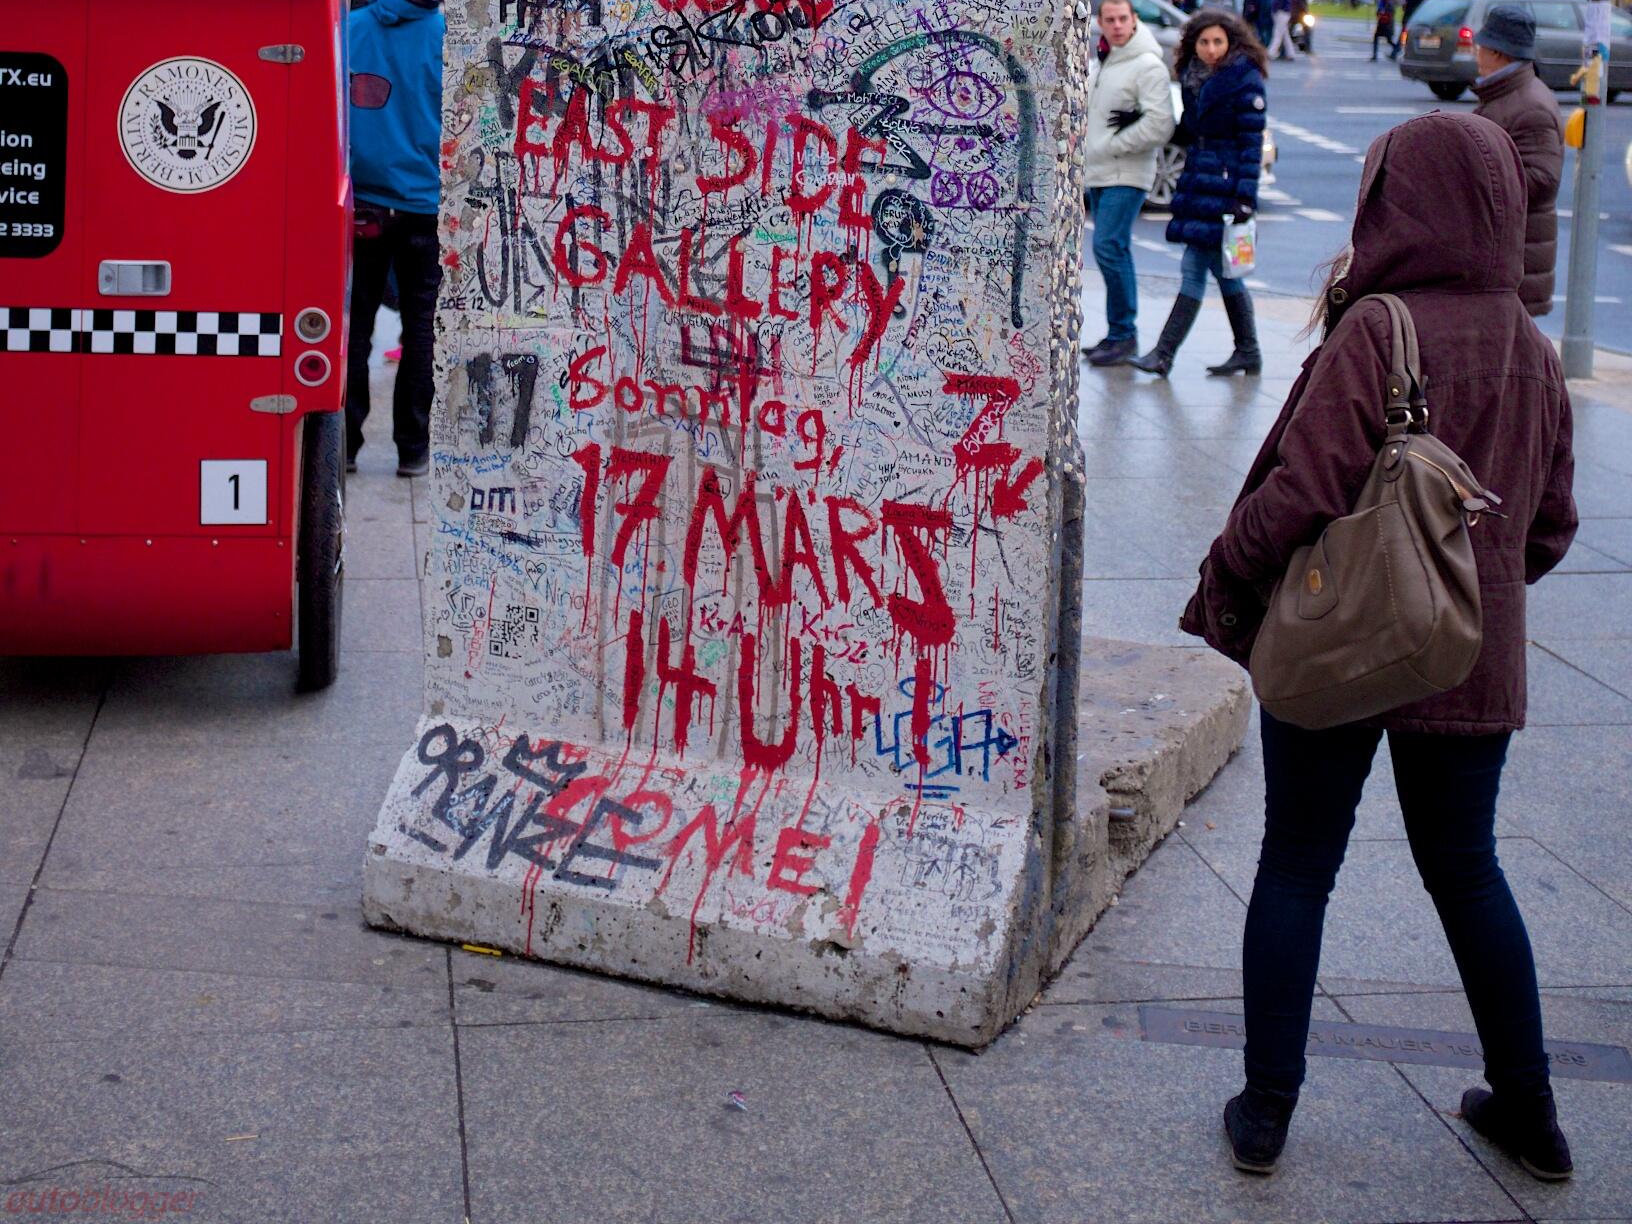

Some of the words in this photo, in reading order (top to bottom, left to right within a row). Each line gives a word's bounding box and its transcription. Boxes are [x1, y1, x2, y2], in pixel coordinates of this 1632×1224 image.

[137, 64, 238, 101] RAMONES
[127, 111, 175, 181] BERLIN
[188, 114, 249, 186] MUSEUM
[513, 76, 676, 166] EAST
[11, 222, 55, 238] 3333
[552, 204, 906, 368] GALLERY
[227, 473, 240, 511] 1
[899, 450, 957, 468] AMAND
[572, 441, 675, 568] 17
